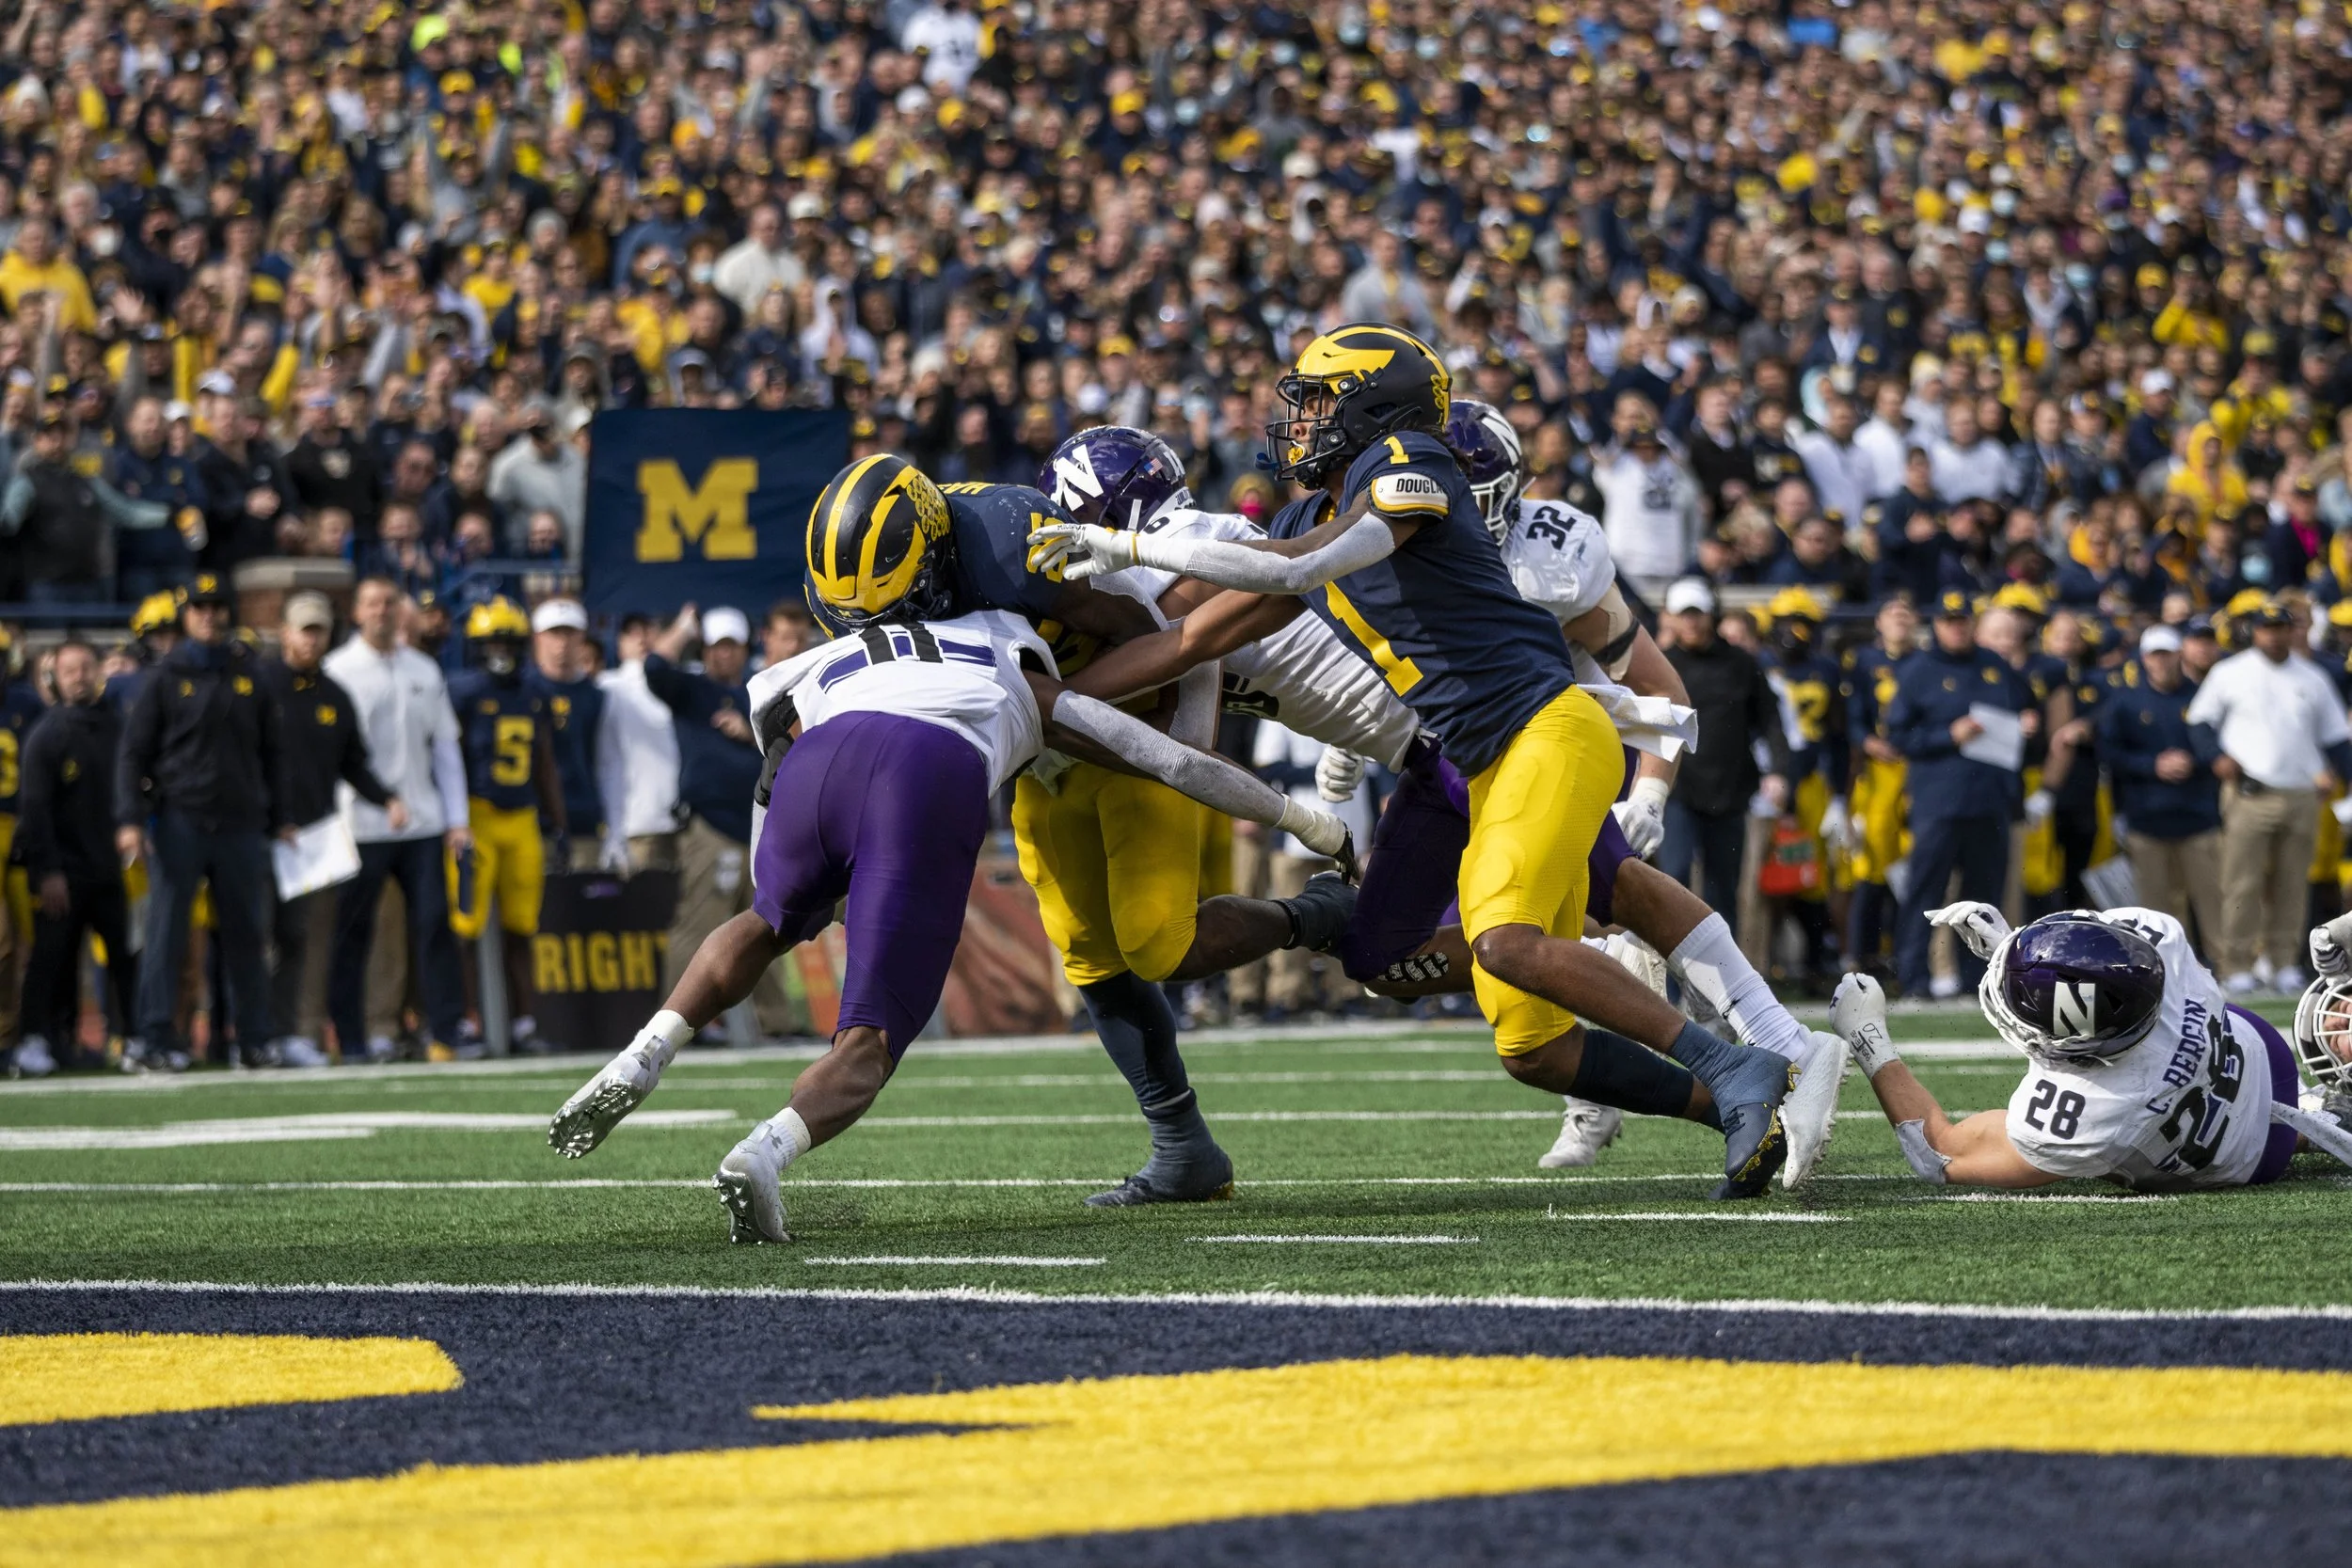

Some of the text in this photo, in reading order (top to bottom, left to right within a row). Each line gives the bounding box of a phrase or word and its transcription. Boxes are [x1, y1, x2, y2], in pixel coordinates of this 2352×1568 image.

[1050, 443, 1104, 512] N
[1383, 435, 1410, 465] 1
[636, 457, 759, 563] M
[1396, 478, 1444, 494] DOUGLA
[1525, 504, 1577, 551] 32
[1324, 580, 1424, 697] 1
[492, 715, 534, 786] 5
[2053, 981, 2096, 1038] N
[2025, 1079, 2086, 1140] 28
